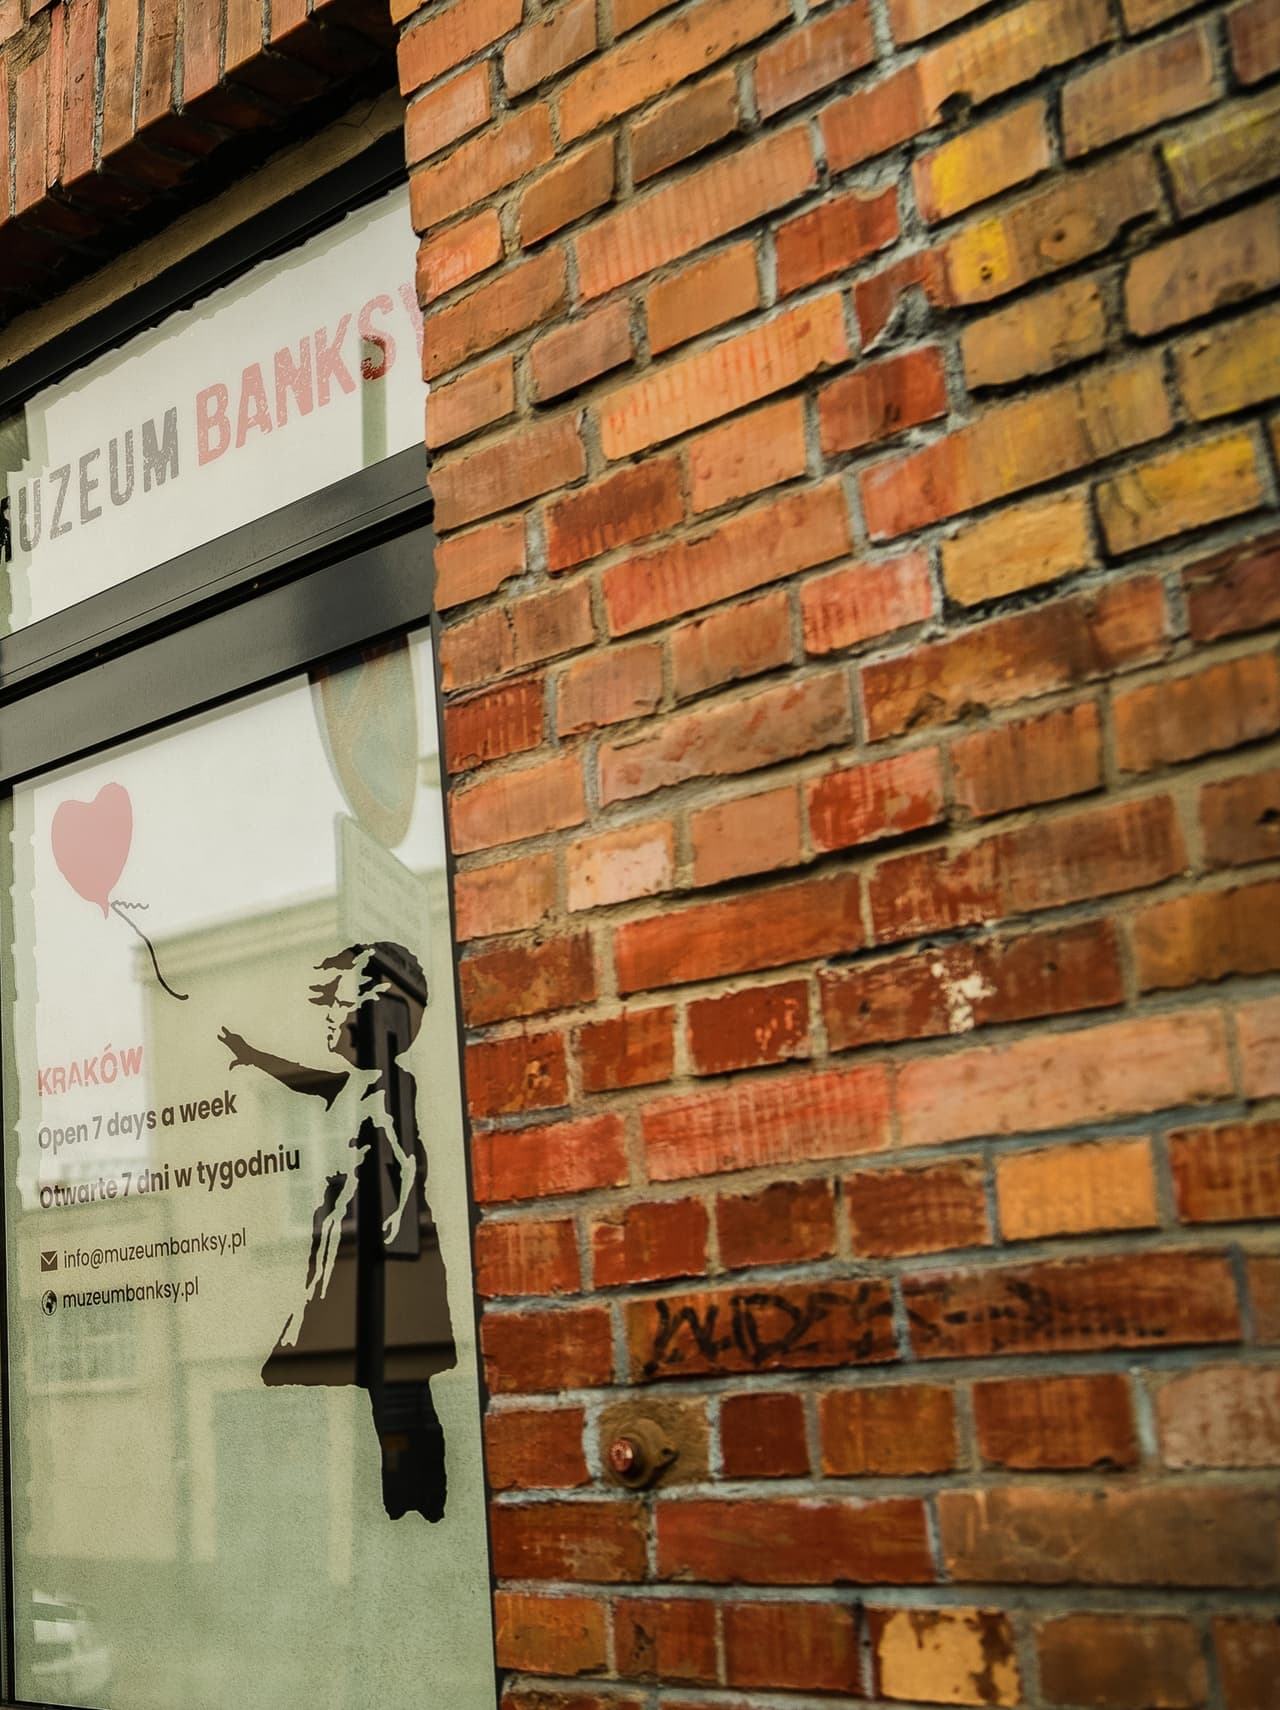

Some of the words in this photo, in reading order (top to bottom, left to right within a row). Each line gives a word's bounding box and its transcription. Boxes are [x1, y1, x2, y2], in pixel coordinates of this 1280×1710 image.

[37, 1044, 144, 1096] KRAKÓW
[38, 1123, 88, 1155] Open
[92, 1115, 103, 1140] 7
[106, 1111, 157, 1141] days
[161, 1106, 175, 1127] a
[179, 1089, 238, 1124] week
[39, 1176, 118, 1209] Otwarte
[122, 1171, 133, 1197] 7
[136, 1163, 170, 1194] dni
[174, 1166, 193, 1188] w
[196, 1144, 301, 1192] tygodniu
[63, 1227, 247, 1270] info@muzeumbanksy.pl
[62, 1276, 200, 1309] muzeumbanksy.pl
